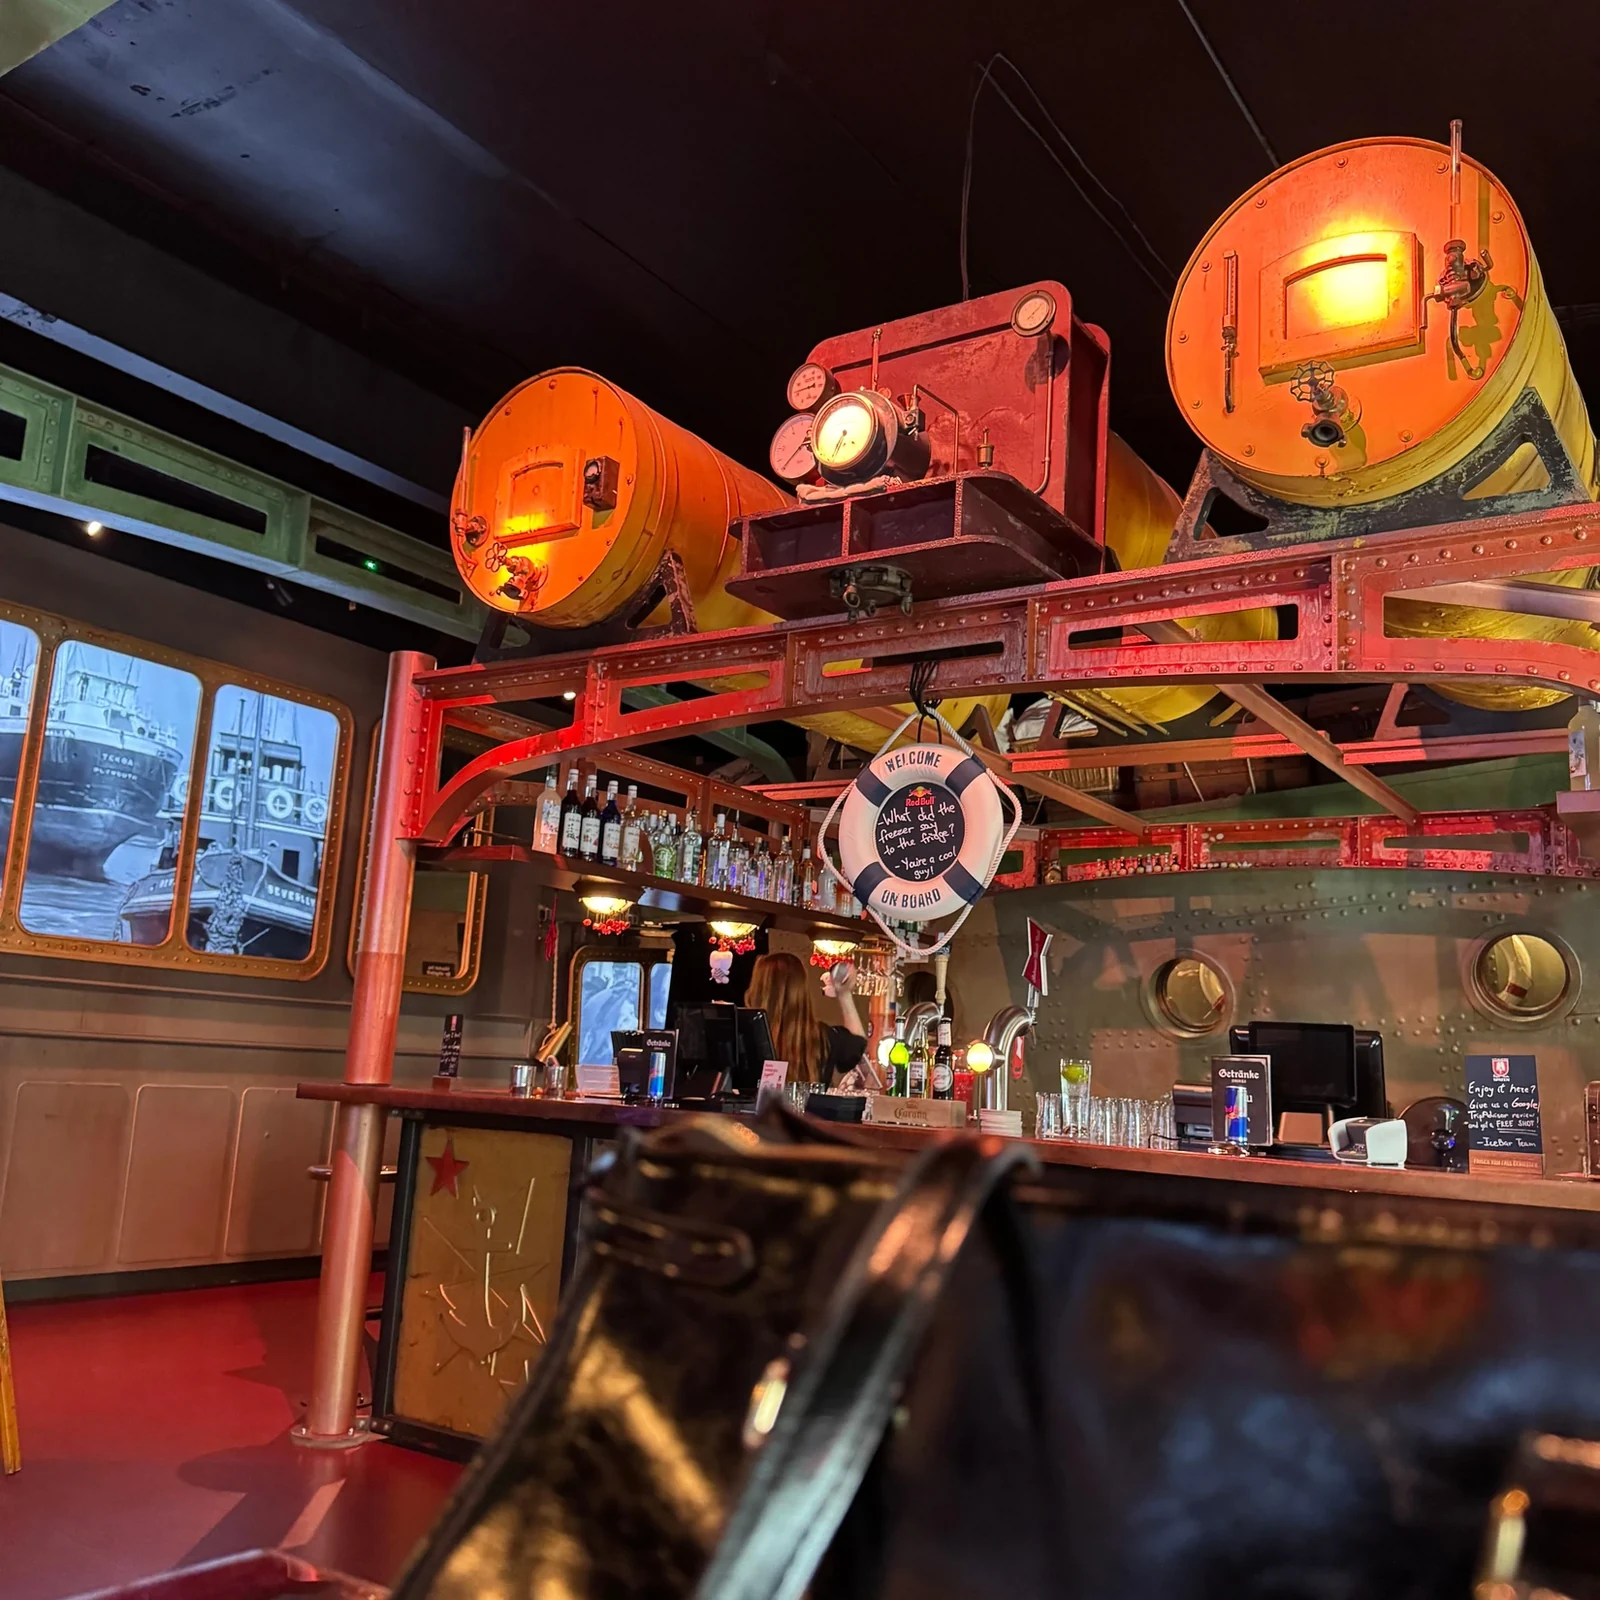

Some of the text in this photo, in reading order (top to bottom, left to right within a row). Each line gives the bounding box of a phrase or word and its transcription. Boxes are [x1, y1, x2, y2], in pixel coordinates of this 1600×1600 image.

[885, 750, 942, 773] WELCOME
[905, 796, 935, 806] Red Bull
[918, 805, 935, 821] did
[938, 801, 956, 816] the
[879, 822, 938, 844] freezer say
[883, 823, 955, 856] to the fridge?
[938, 845, 957, 861] cool
[914, 865, 934, 880] guy!
[881, 888, 941, 909] ON BOARD
[1218, 1068, 1260, 1079] Getränke
[1468, 1081, 1536, 1098] Enjoy it here?
[1469, 1098, 1488, 1109] Give
[894, 1107, 929, 1121] Corona
[1515, 1138, 1536, 1147] Team
